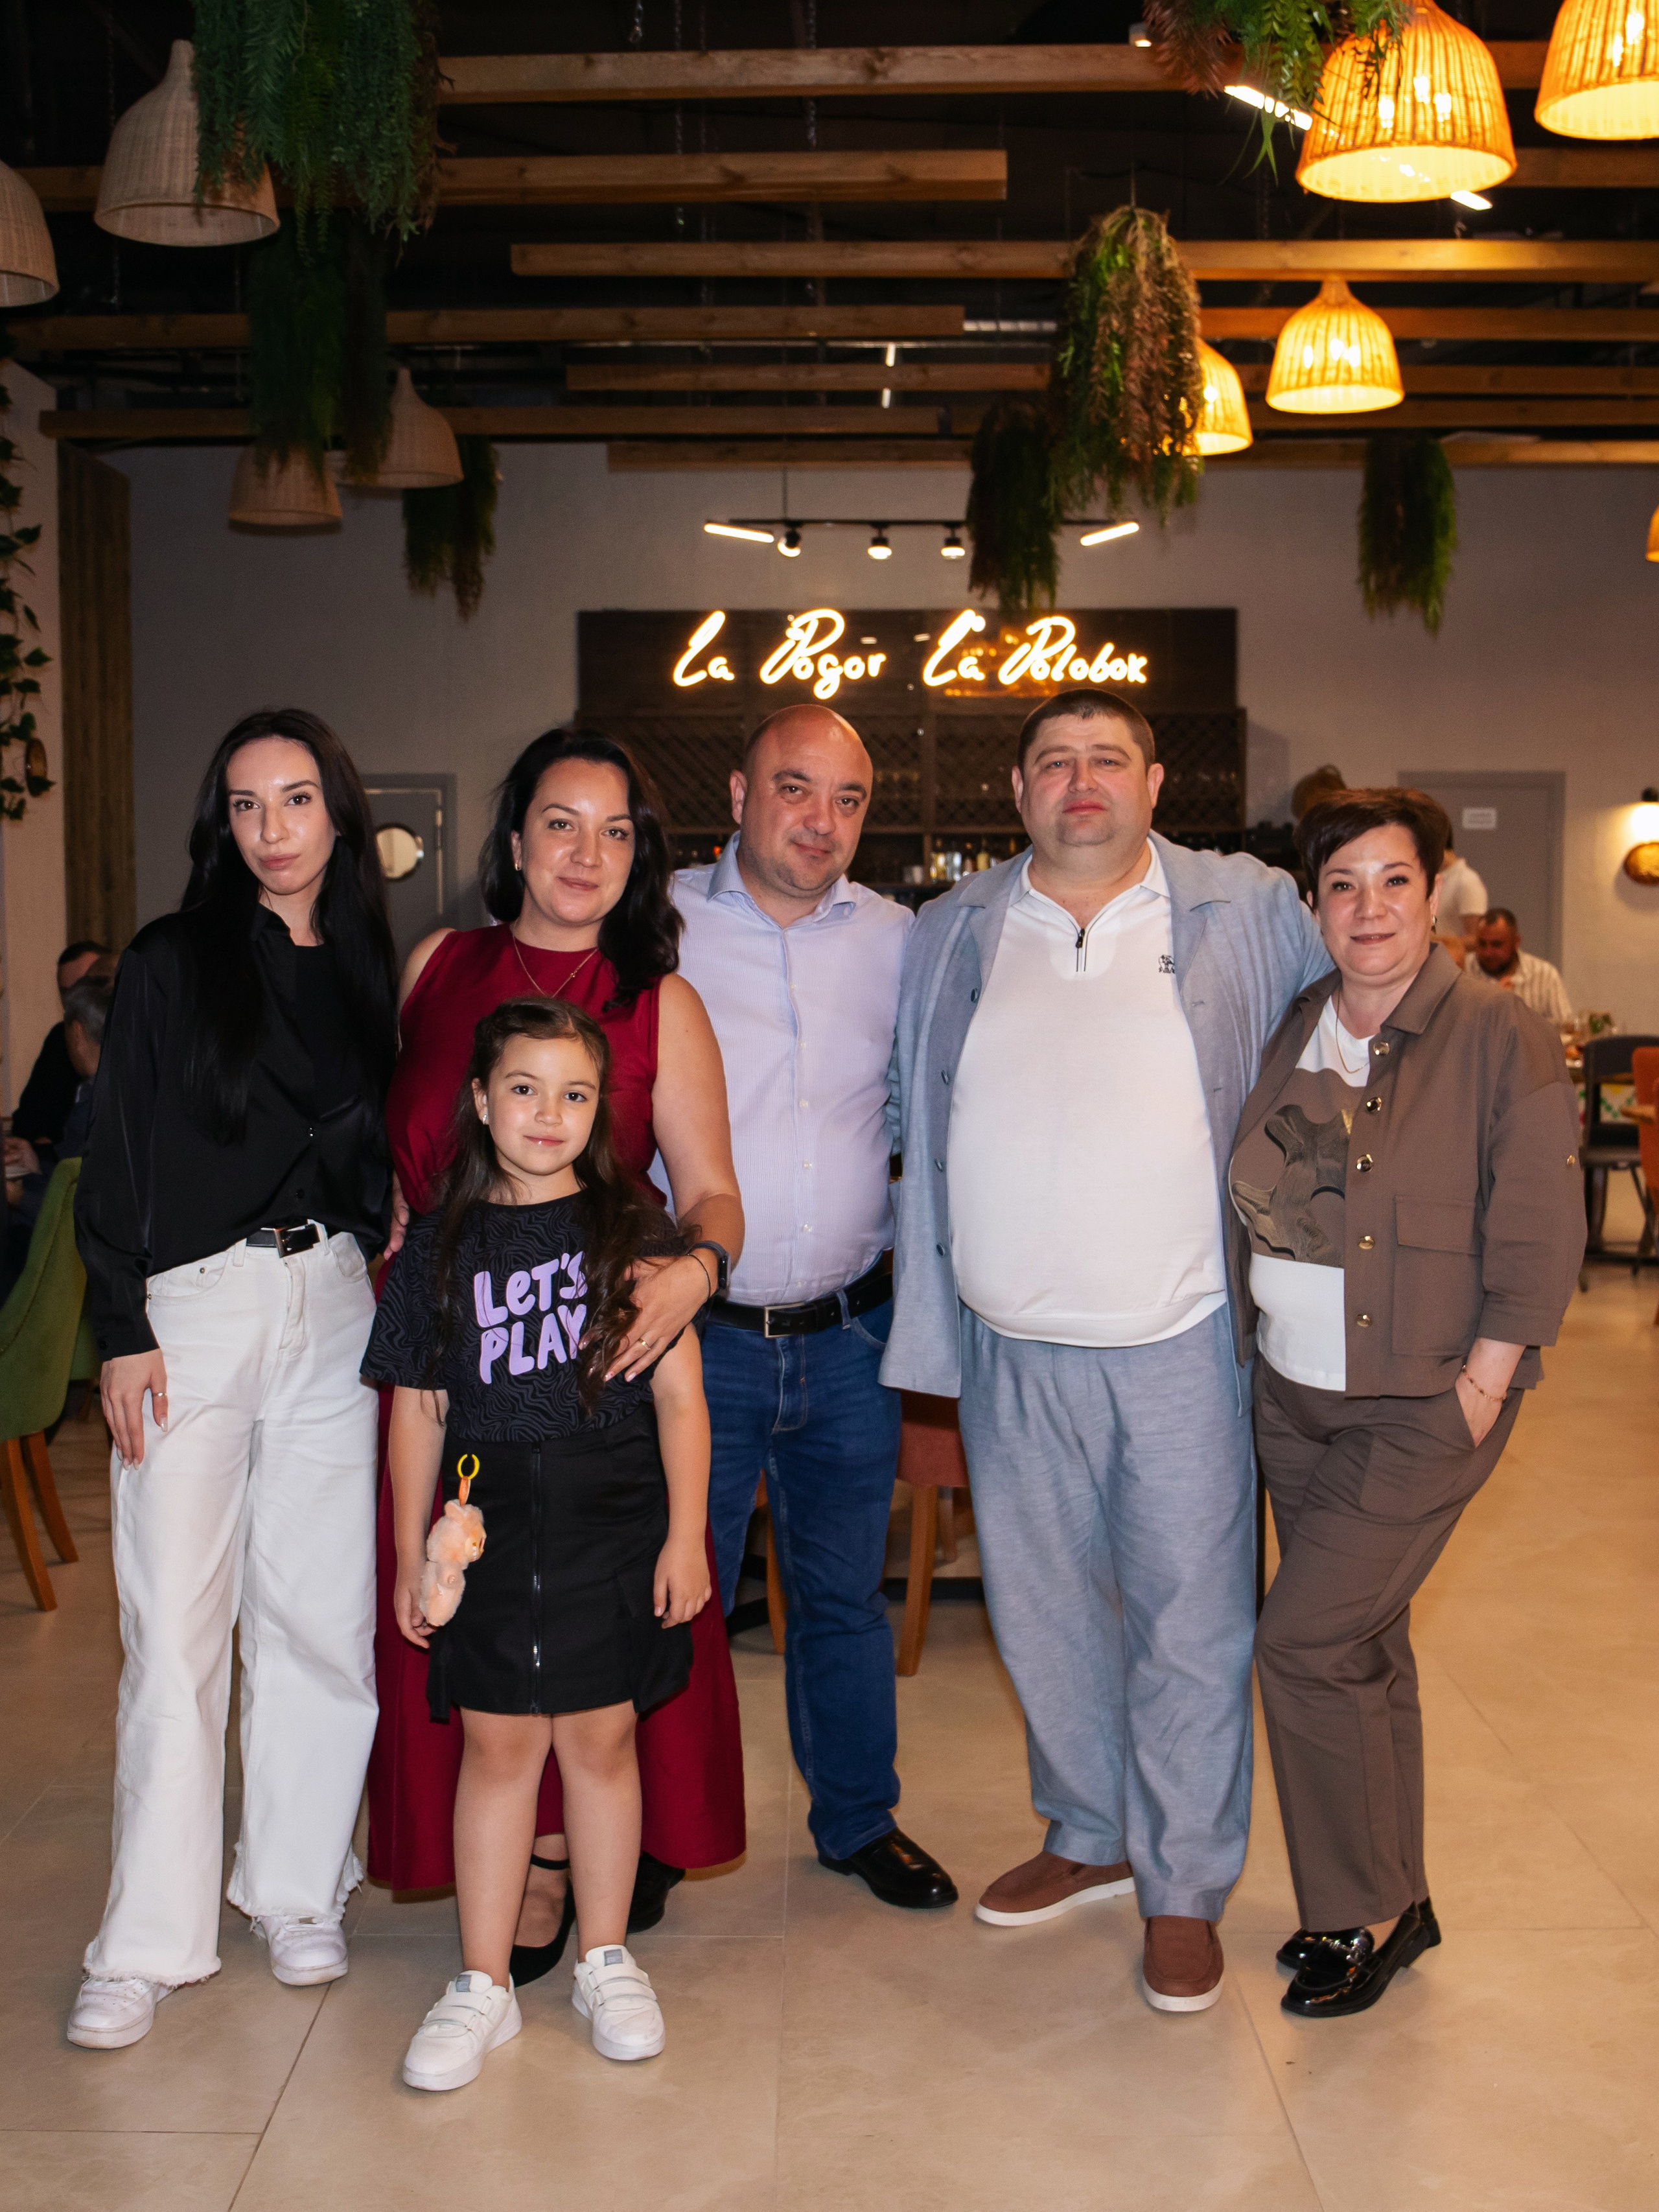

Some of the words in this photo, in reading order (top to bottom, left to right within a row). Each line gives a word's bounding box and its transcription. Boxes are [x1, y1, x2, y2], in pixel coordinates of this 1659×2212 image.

[673, 611, 735, 687] La
[923, 609, 986, 687] La
[480, 1303, 587, 1384] PLAY
